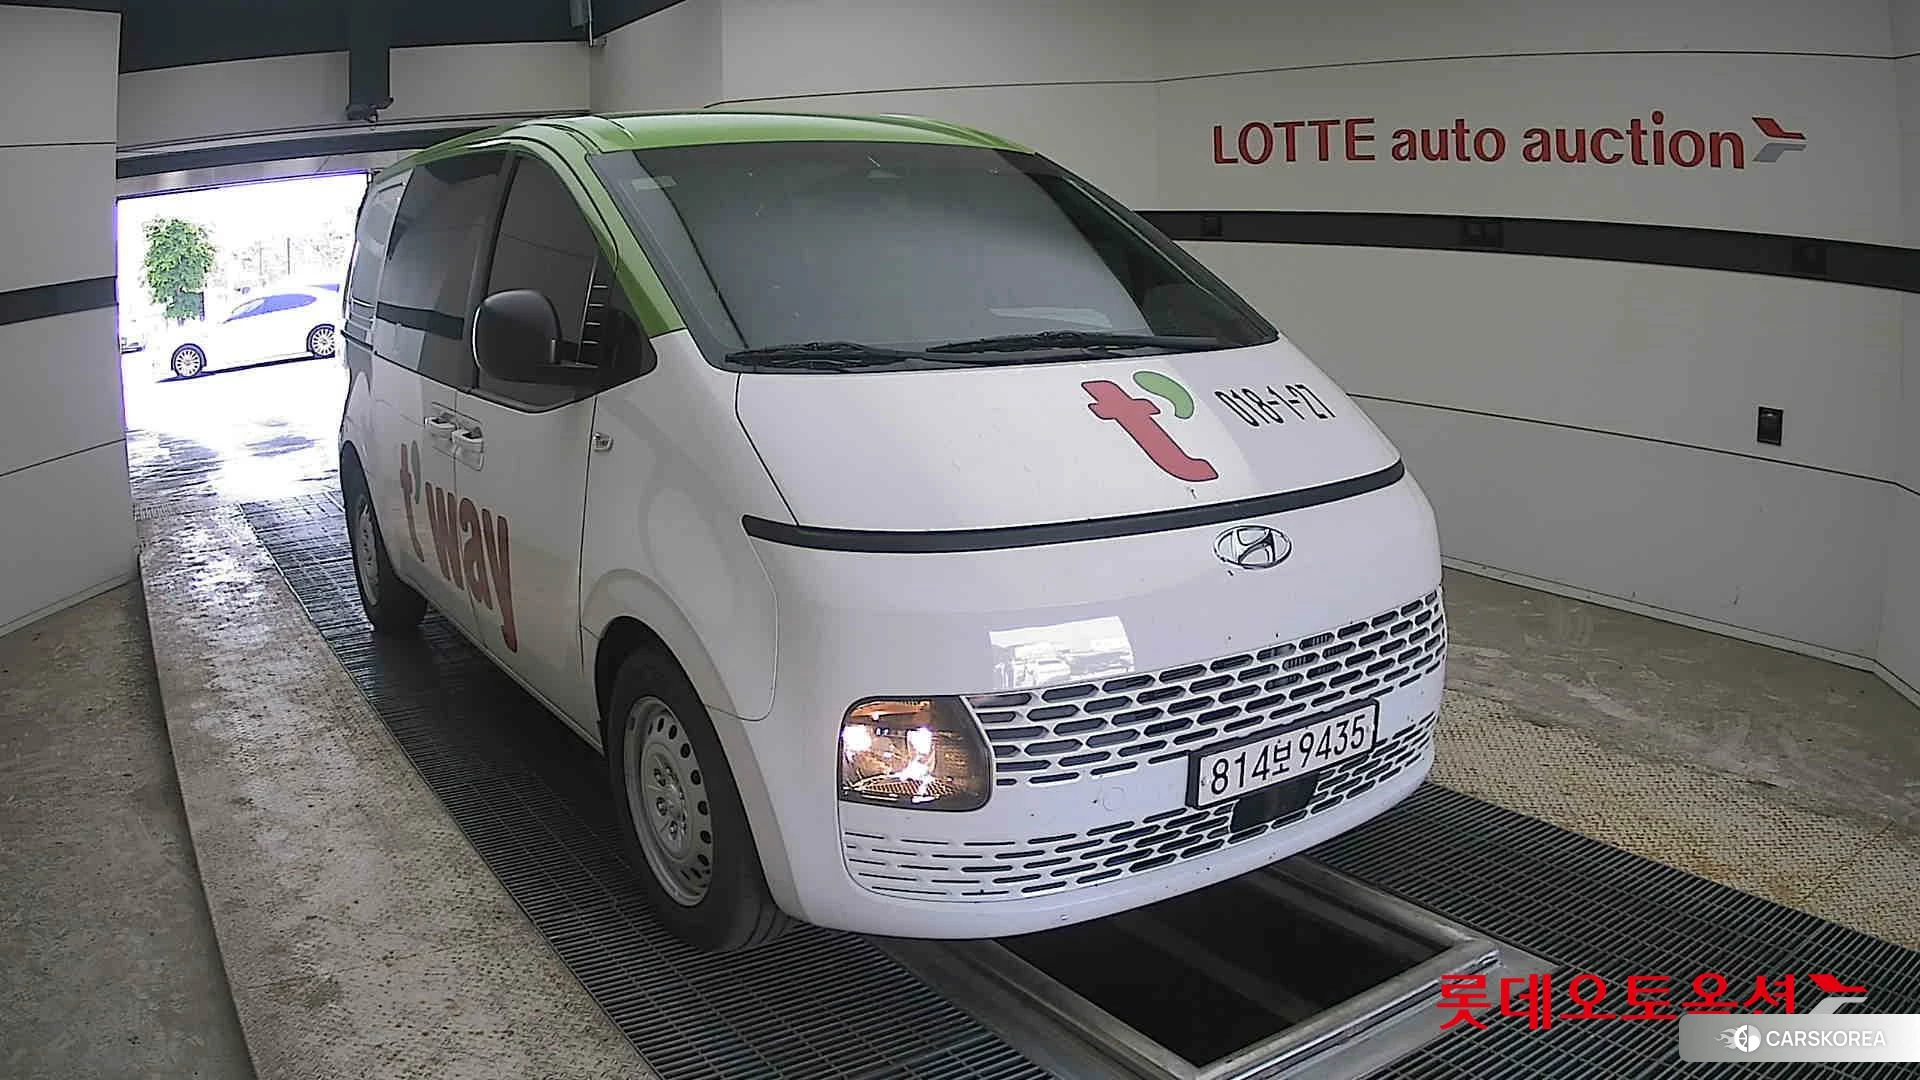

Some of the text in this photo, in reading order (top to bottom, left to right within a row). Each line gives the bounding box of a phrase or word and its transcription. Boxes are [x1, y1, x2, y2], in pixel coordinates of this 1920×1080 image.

[1213, 110, 1745, 169] LOTTE auto auction
[1214, 384, 1336, 427] 018-1-27
